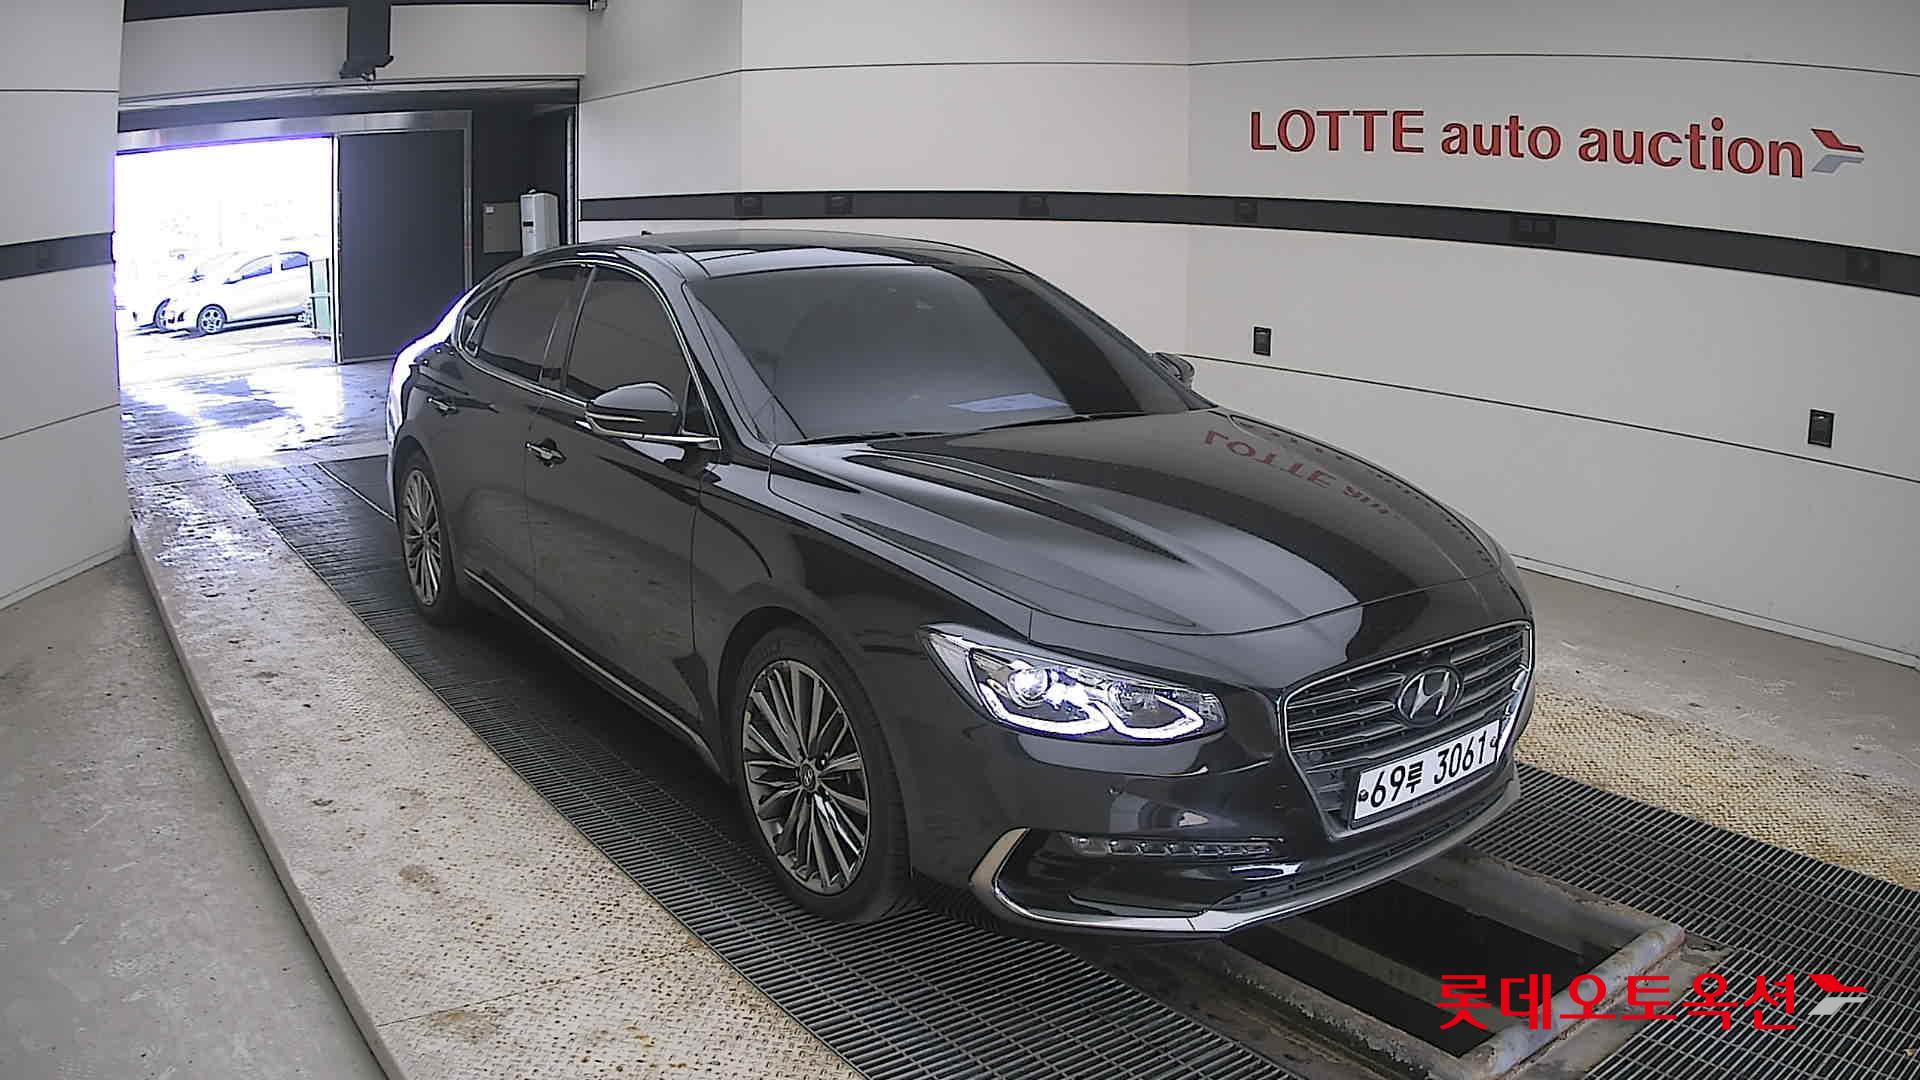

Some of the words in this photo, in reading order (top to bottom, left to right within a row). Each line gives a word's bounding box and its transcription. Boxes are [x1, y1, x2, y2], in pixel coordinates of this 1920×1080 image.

[1250, 110, 1425, 154] LOTTE
[1441, 115, 1563, 161] auto
[1577, 116, 1805, 179] auction
[1370, 760, 1424, 808] 69루
[1434, 730, 1487, 785] 3061
